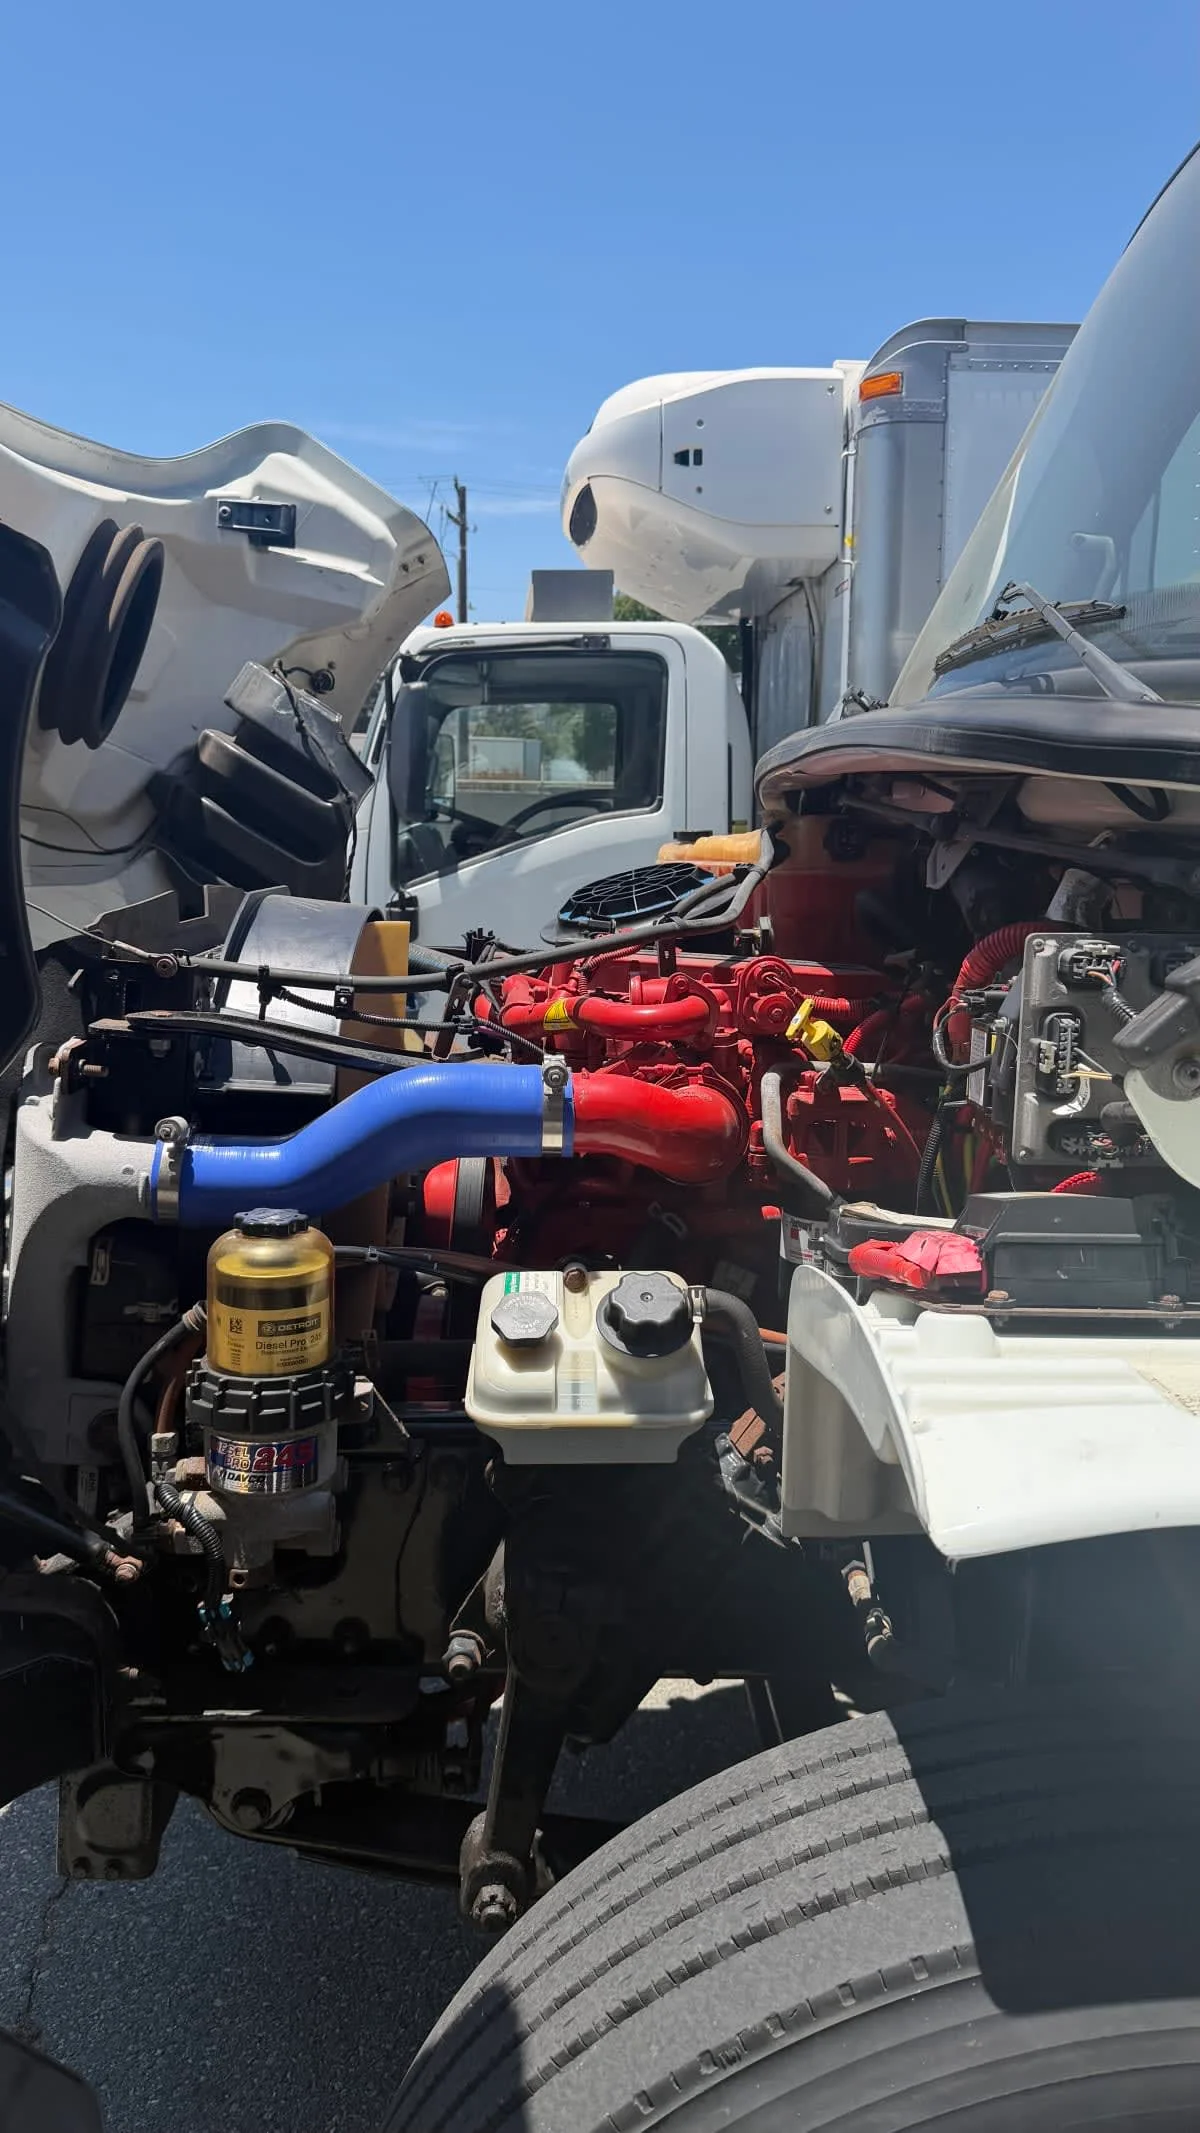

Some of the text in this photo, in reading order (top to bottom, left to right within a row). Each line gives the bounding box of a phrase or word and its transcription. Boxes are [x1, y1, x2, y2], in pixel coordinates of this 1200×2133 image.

[278, 1319, 318, 1331] DETROIT
[256, 1340, 287, 1349] Diesel
[290, 1338, 306, 1348] Pro
[224, 1456, 251, 1471] PRO
